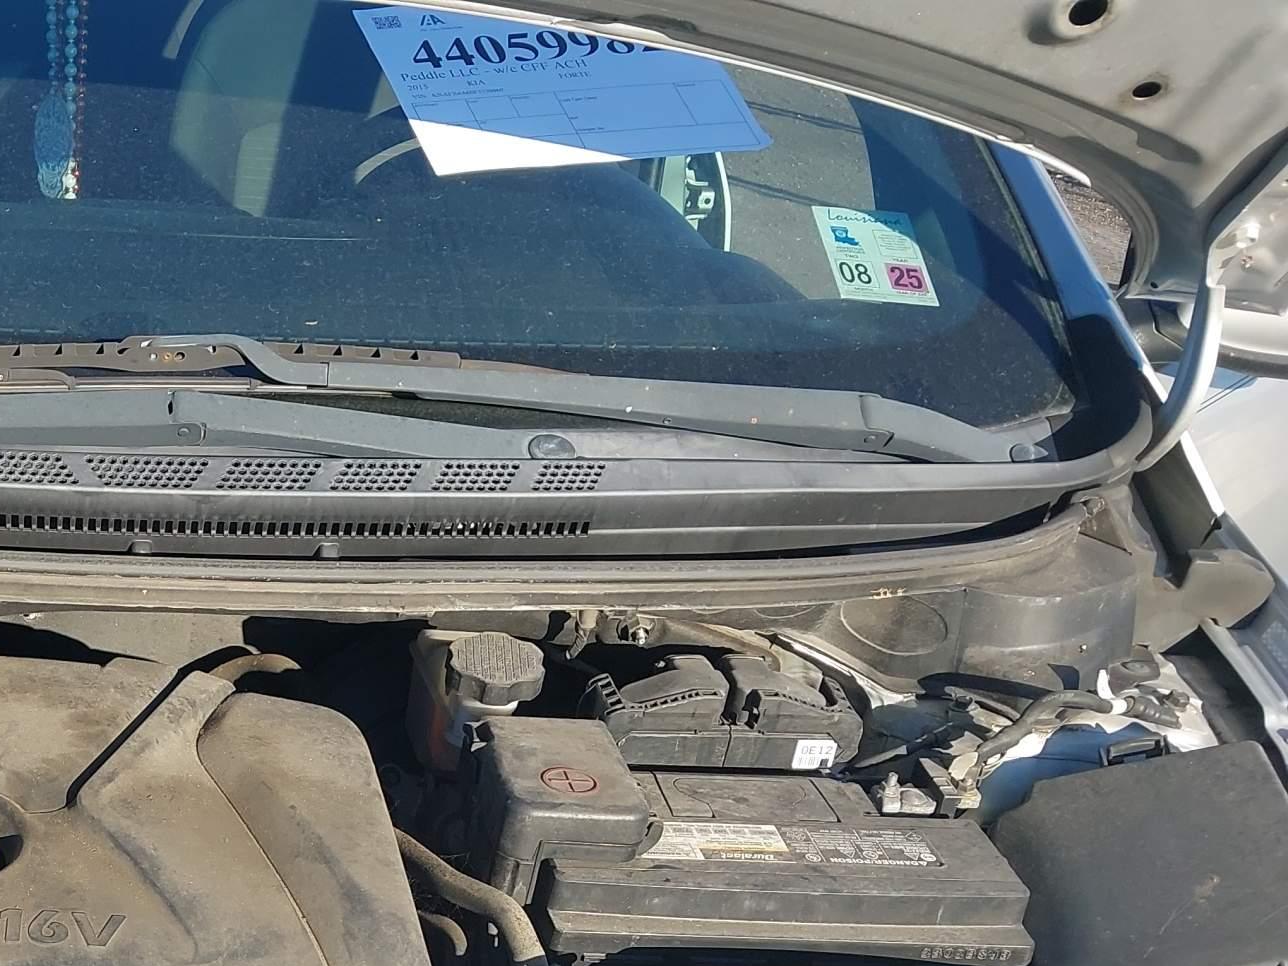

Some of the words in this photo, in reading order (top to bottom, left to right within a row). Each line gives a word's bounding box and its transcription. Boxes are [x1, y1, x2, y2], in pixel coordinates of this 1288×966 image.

[400, 69, 448, 82] Peddle
[449, 67, 480, 78] LLC
[555, 59, 588, 71] ACH
[838, 262, 872, 285] 08
[890, 266, 923, 290] 25
[720, 853, 778, 861] Duralast
